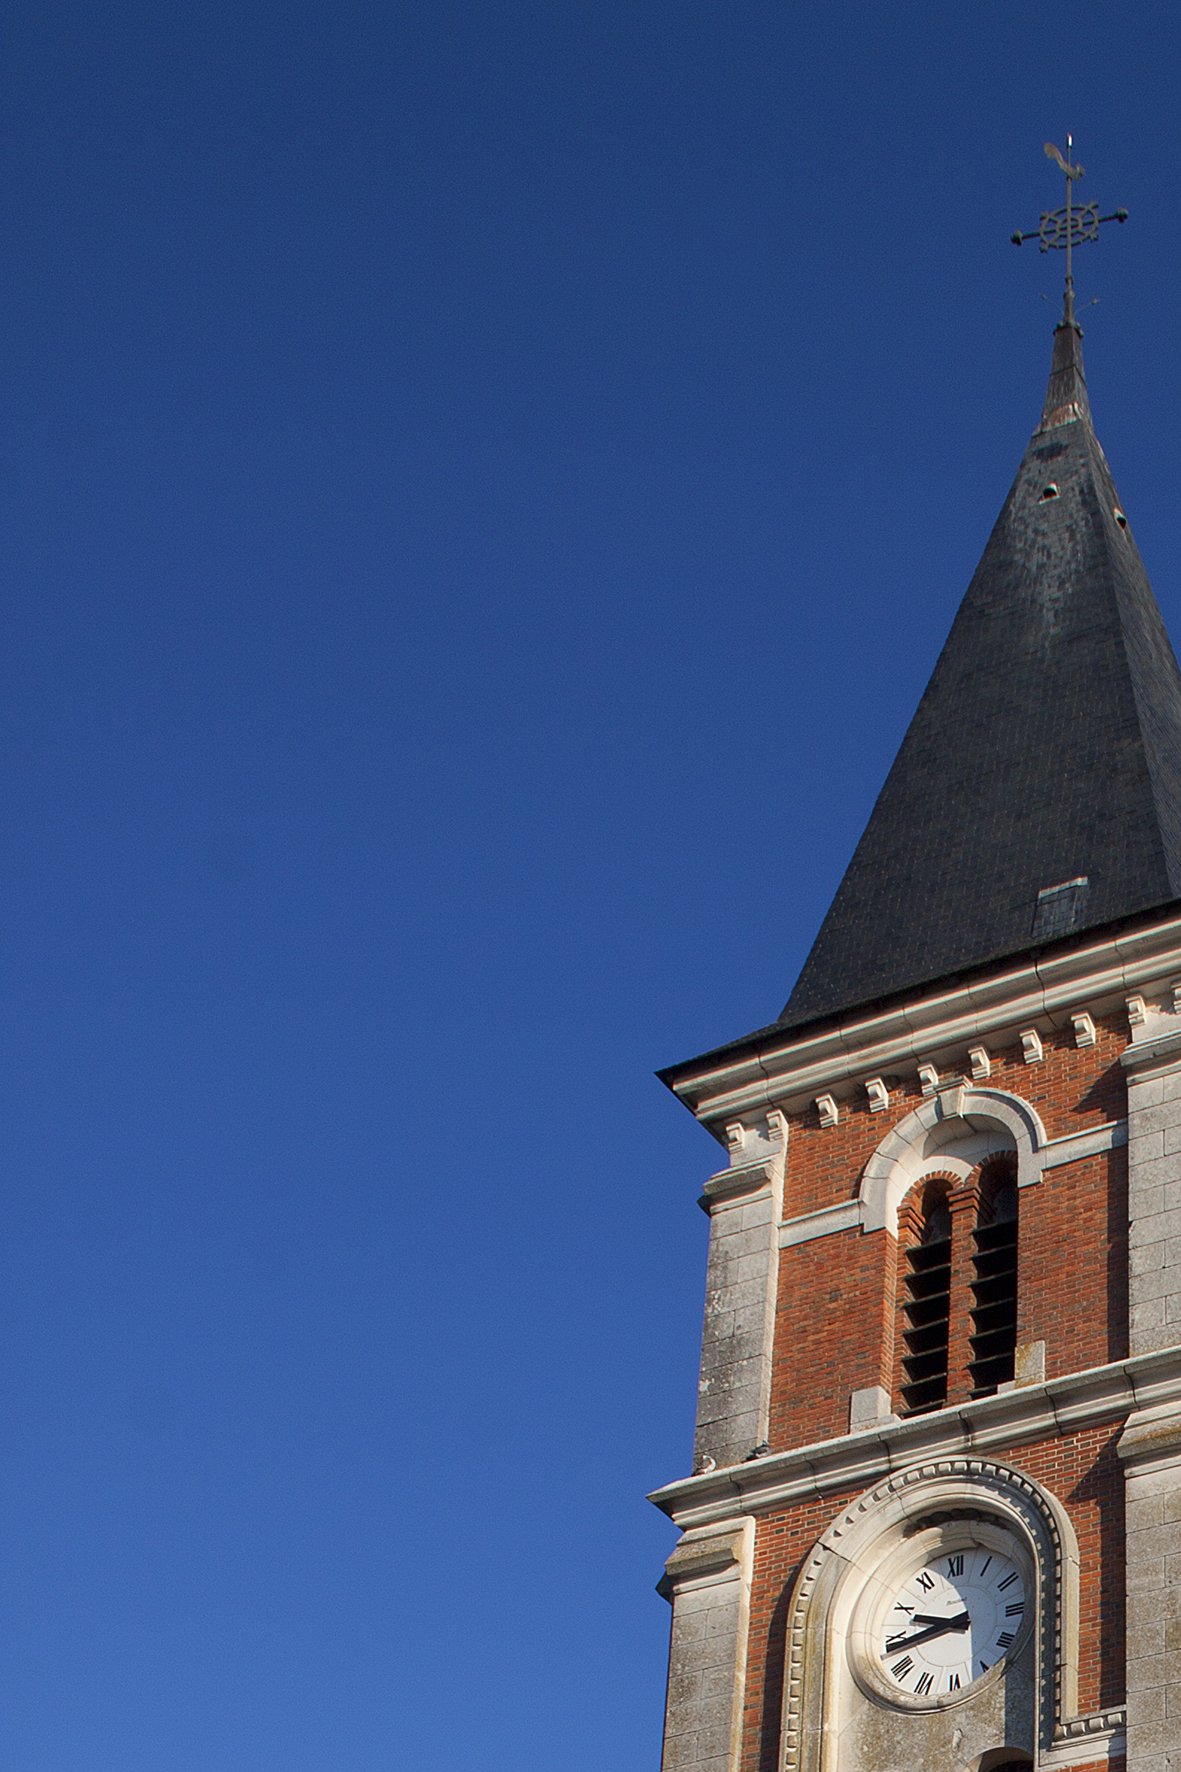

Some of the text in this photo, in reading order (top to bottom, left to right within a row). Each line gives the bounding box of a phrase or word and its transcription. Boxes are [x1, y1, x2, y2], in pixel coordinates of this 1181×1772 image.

[948, 1555, 964, 1577] XII
[916, 1572, 934, 1593] XI
[894, 1602, 915, 1615] X
